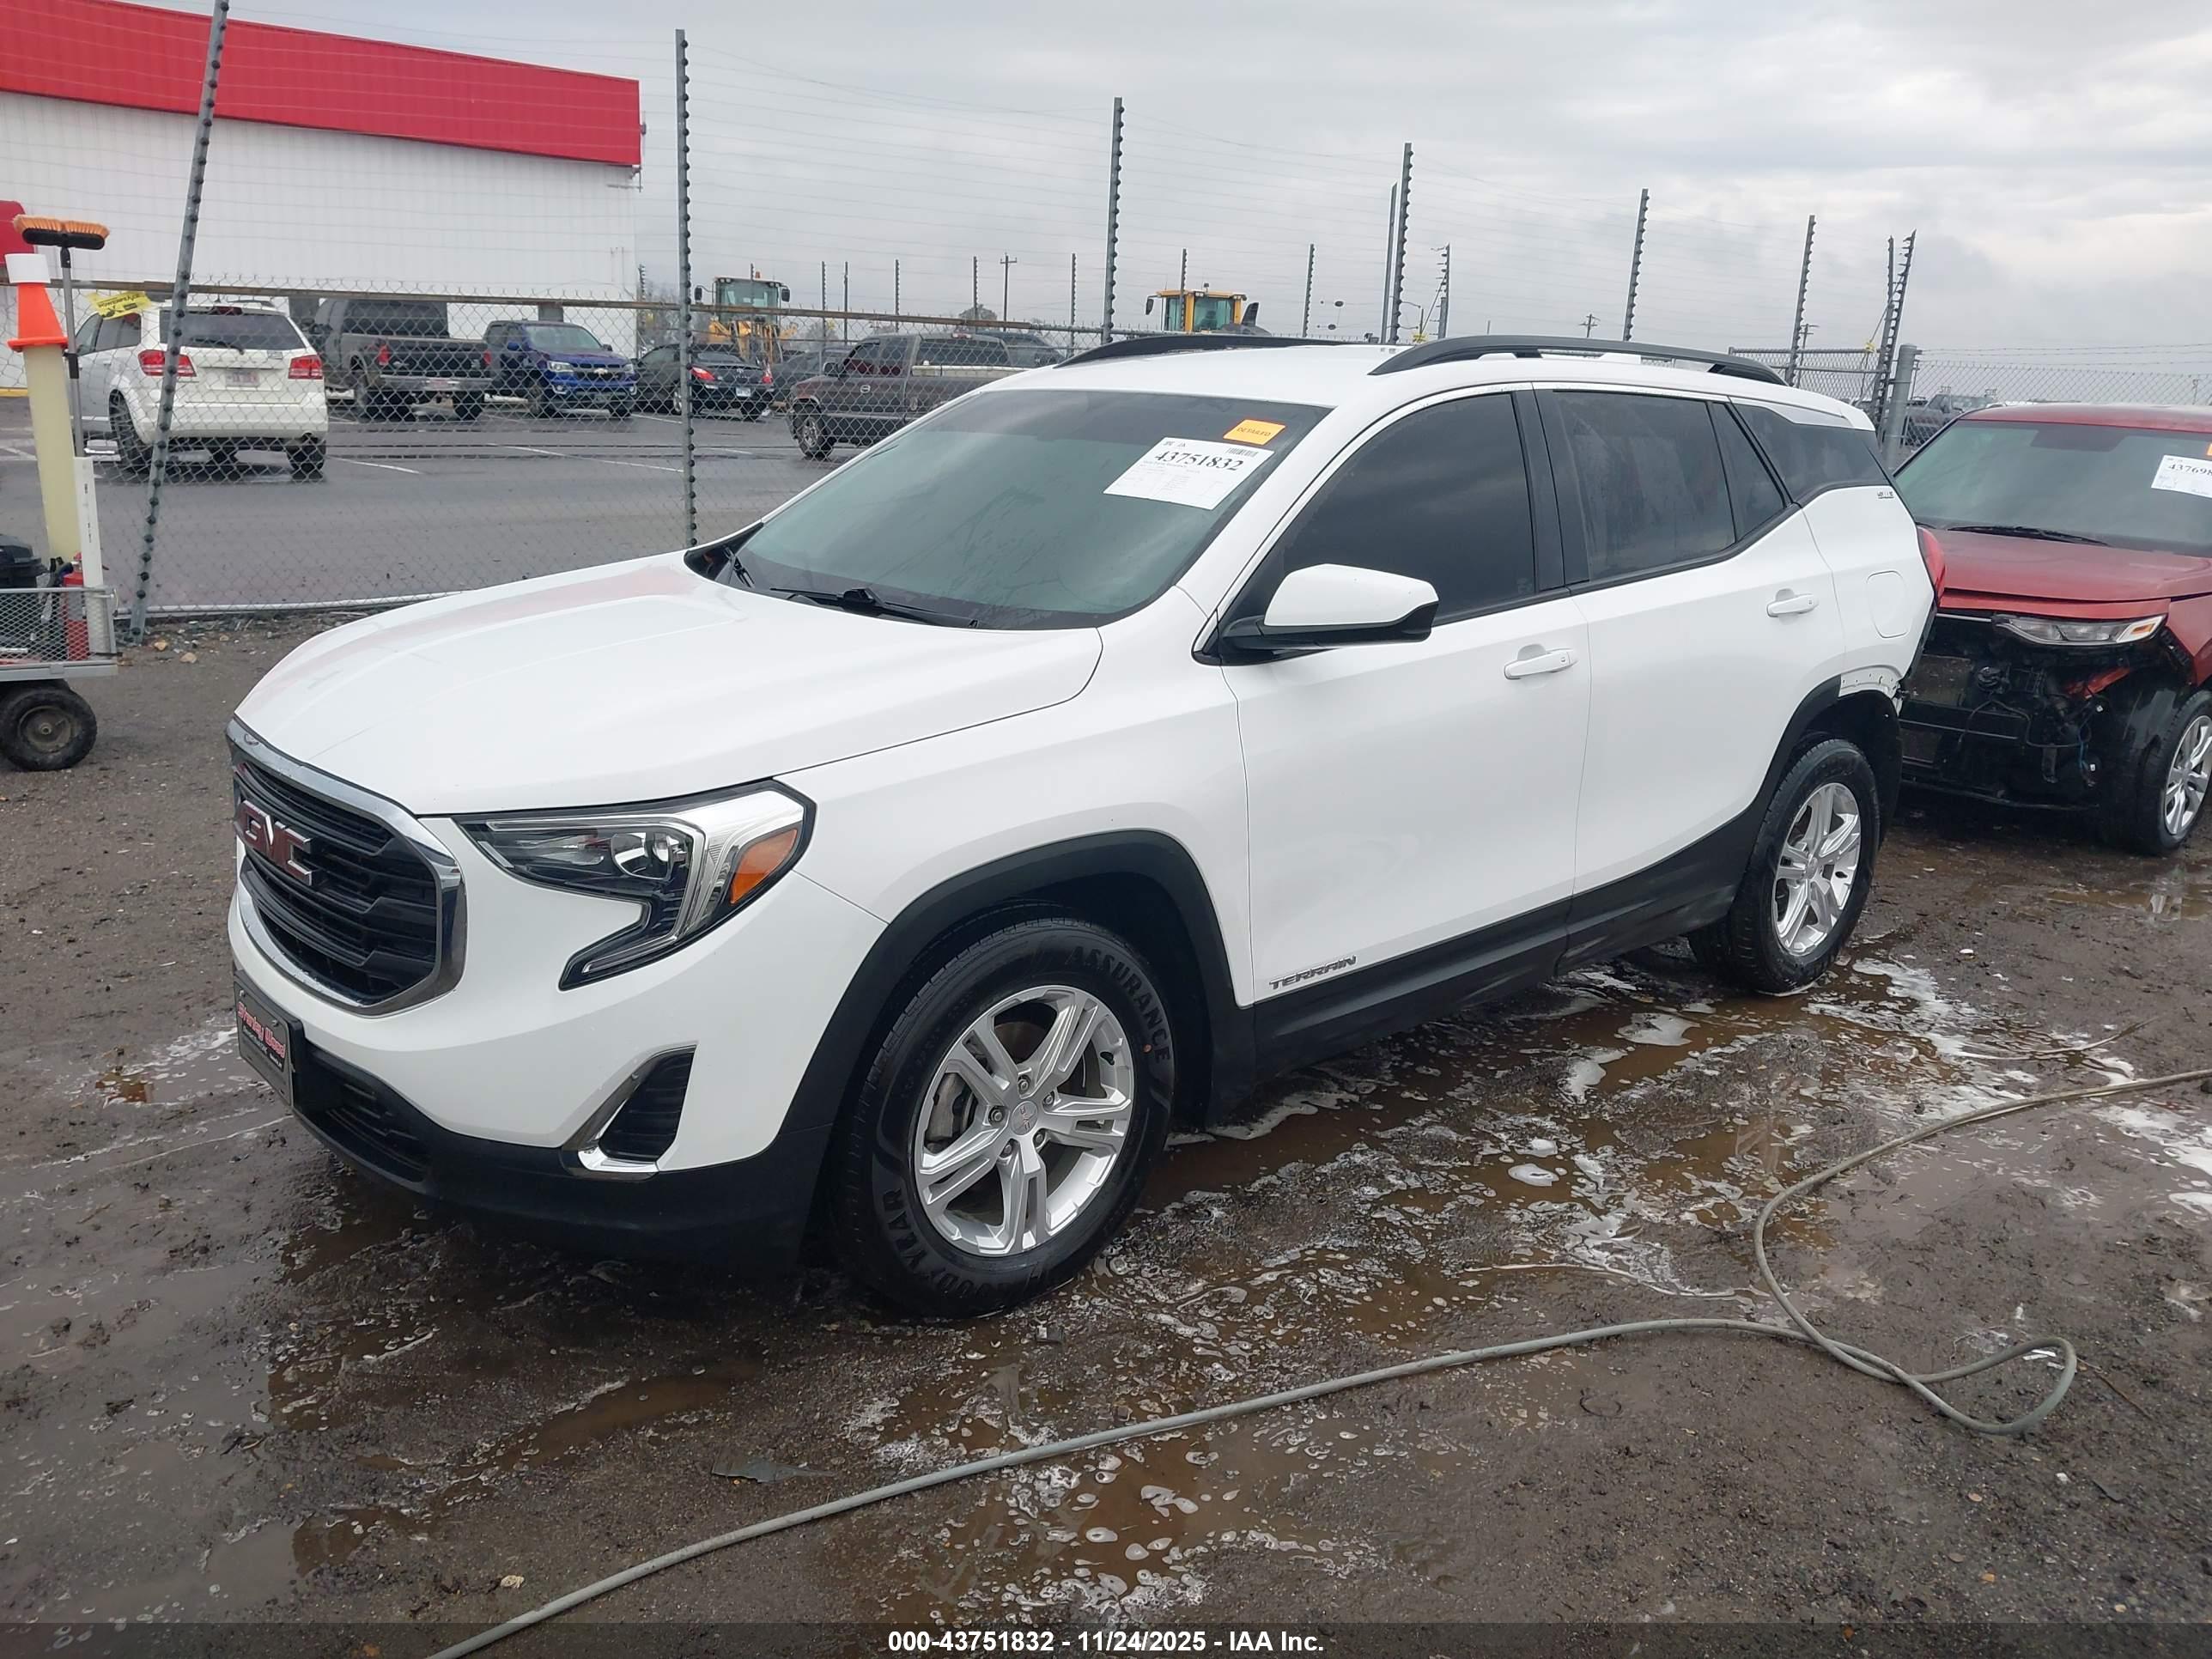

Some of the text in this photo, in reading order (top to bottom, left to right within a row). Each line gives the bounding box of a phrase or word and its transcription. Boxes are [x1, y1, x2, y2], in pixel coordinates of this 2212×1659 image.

[1155, 451, 1244, 471] 43751832
[234, 799, 313, 886] GMC
[1268, 955, 1357, 990] TERRAIN
[1072, 945, 1171, 1064] ASSURANCE
